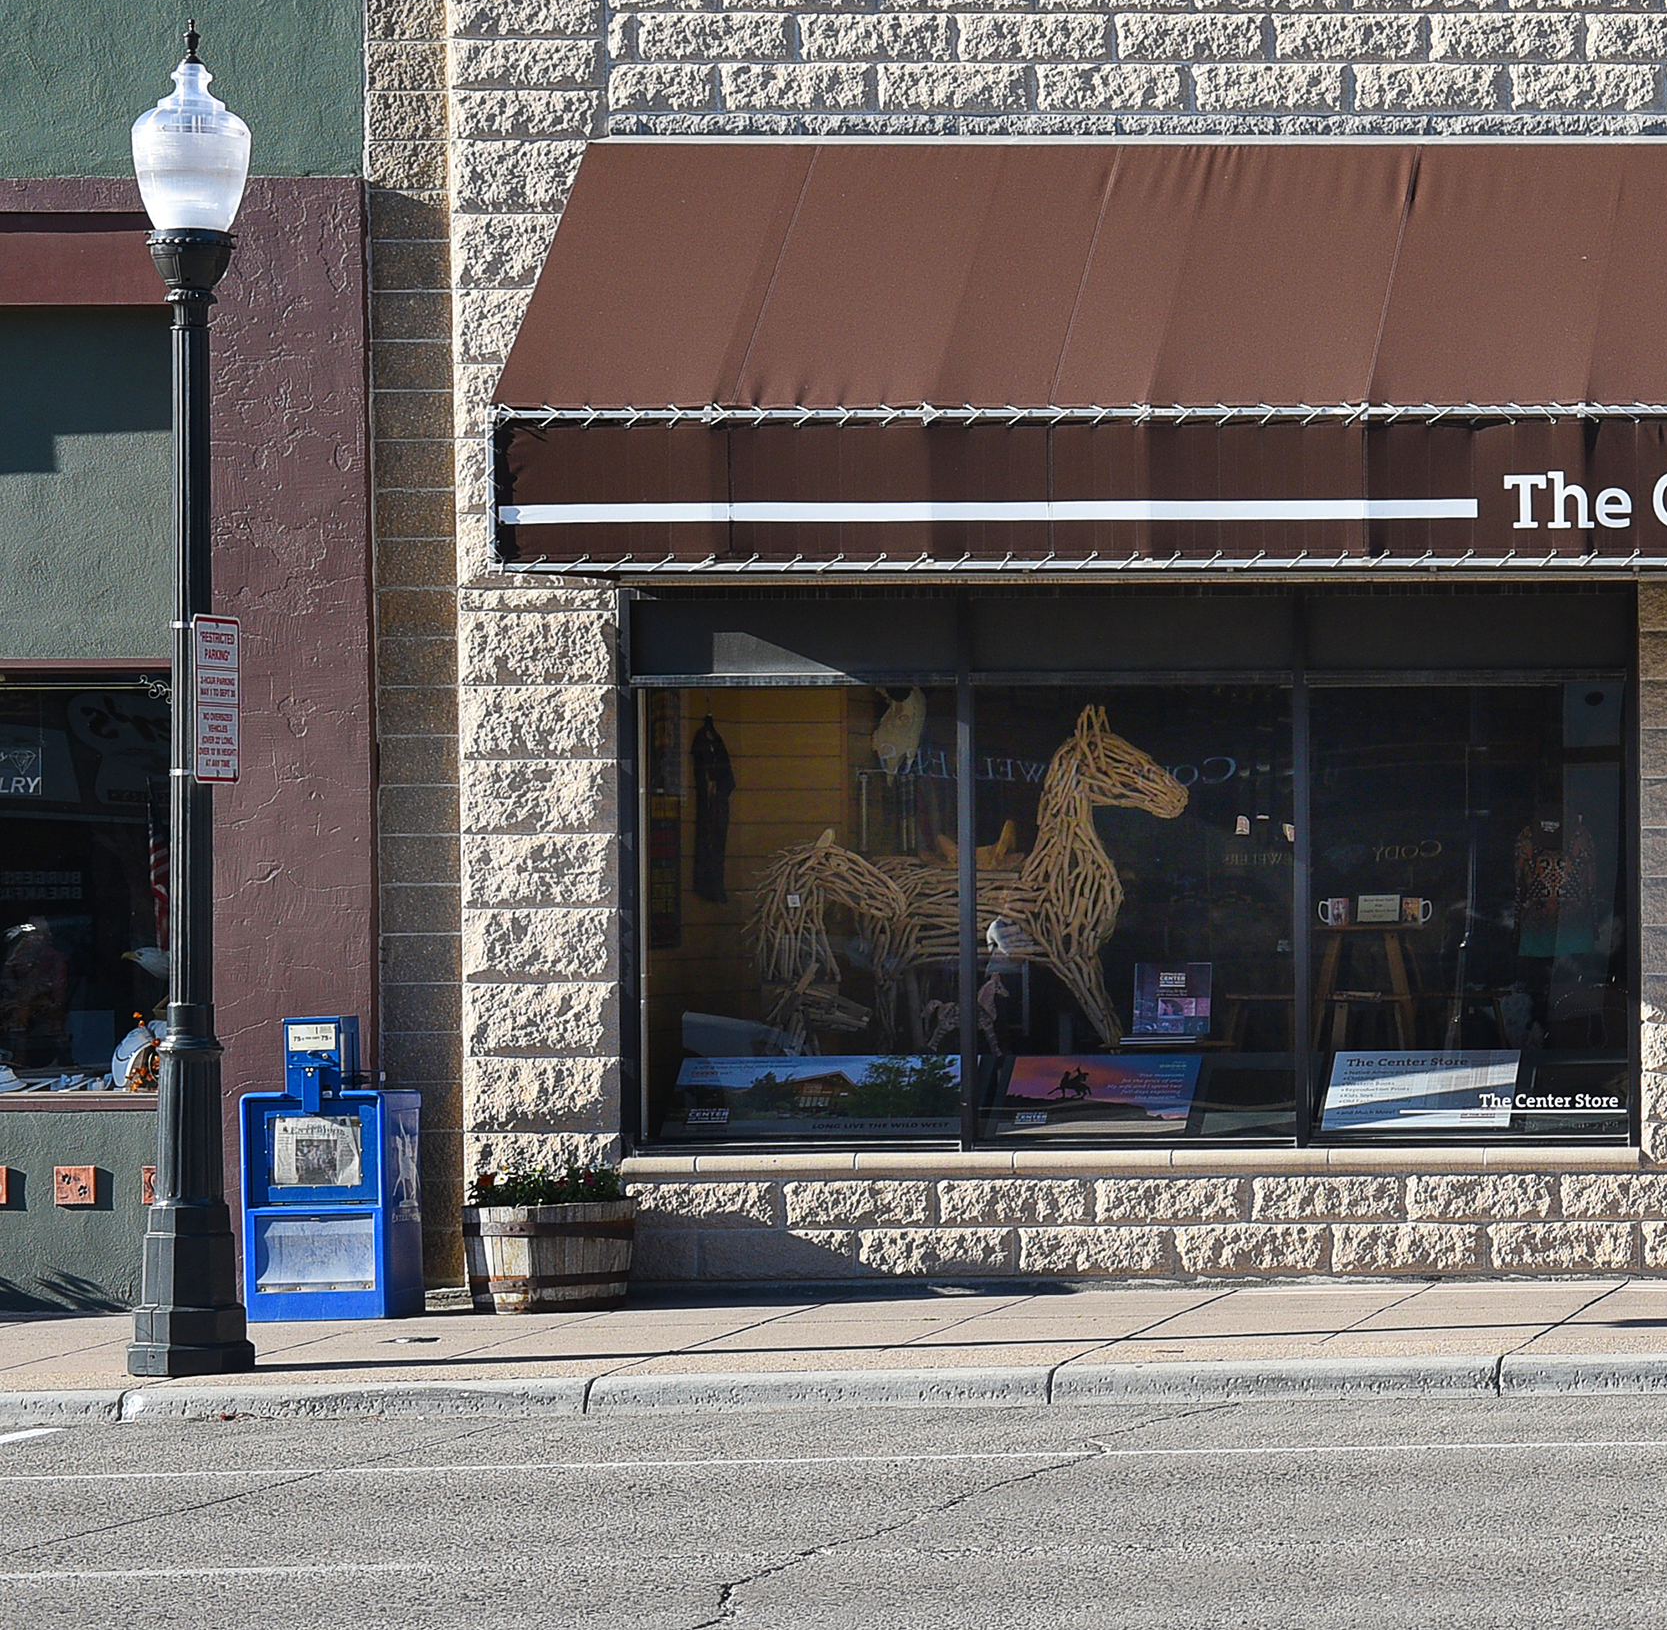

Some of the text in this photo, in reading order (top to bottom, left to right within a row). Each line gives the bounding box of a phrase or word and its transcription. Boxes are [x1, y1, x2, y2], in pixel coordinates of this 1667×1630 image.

[1503, 471, 1632, 530] The
[1347, 1058, 1374, 1067] The
[1378, 1058, 1427, 1067] Center
[1430, 1057, 1468, 1066] Store
[1479, 1093, 1618, 1108] The Center Store
